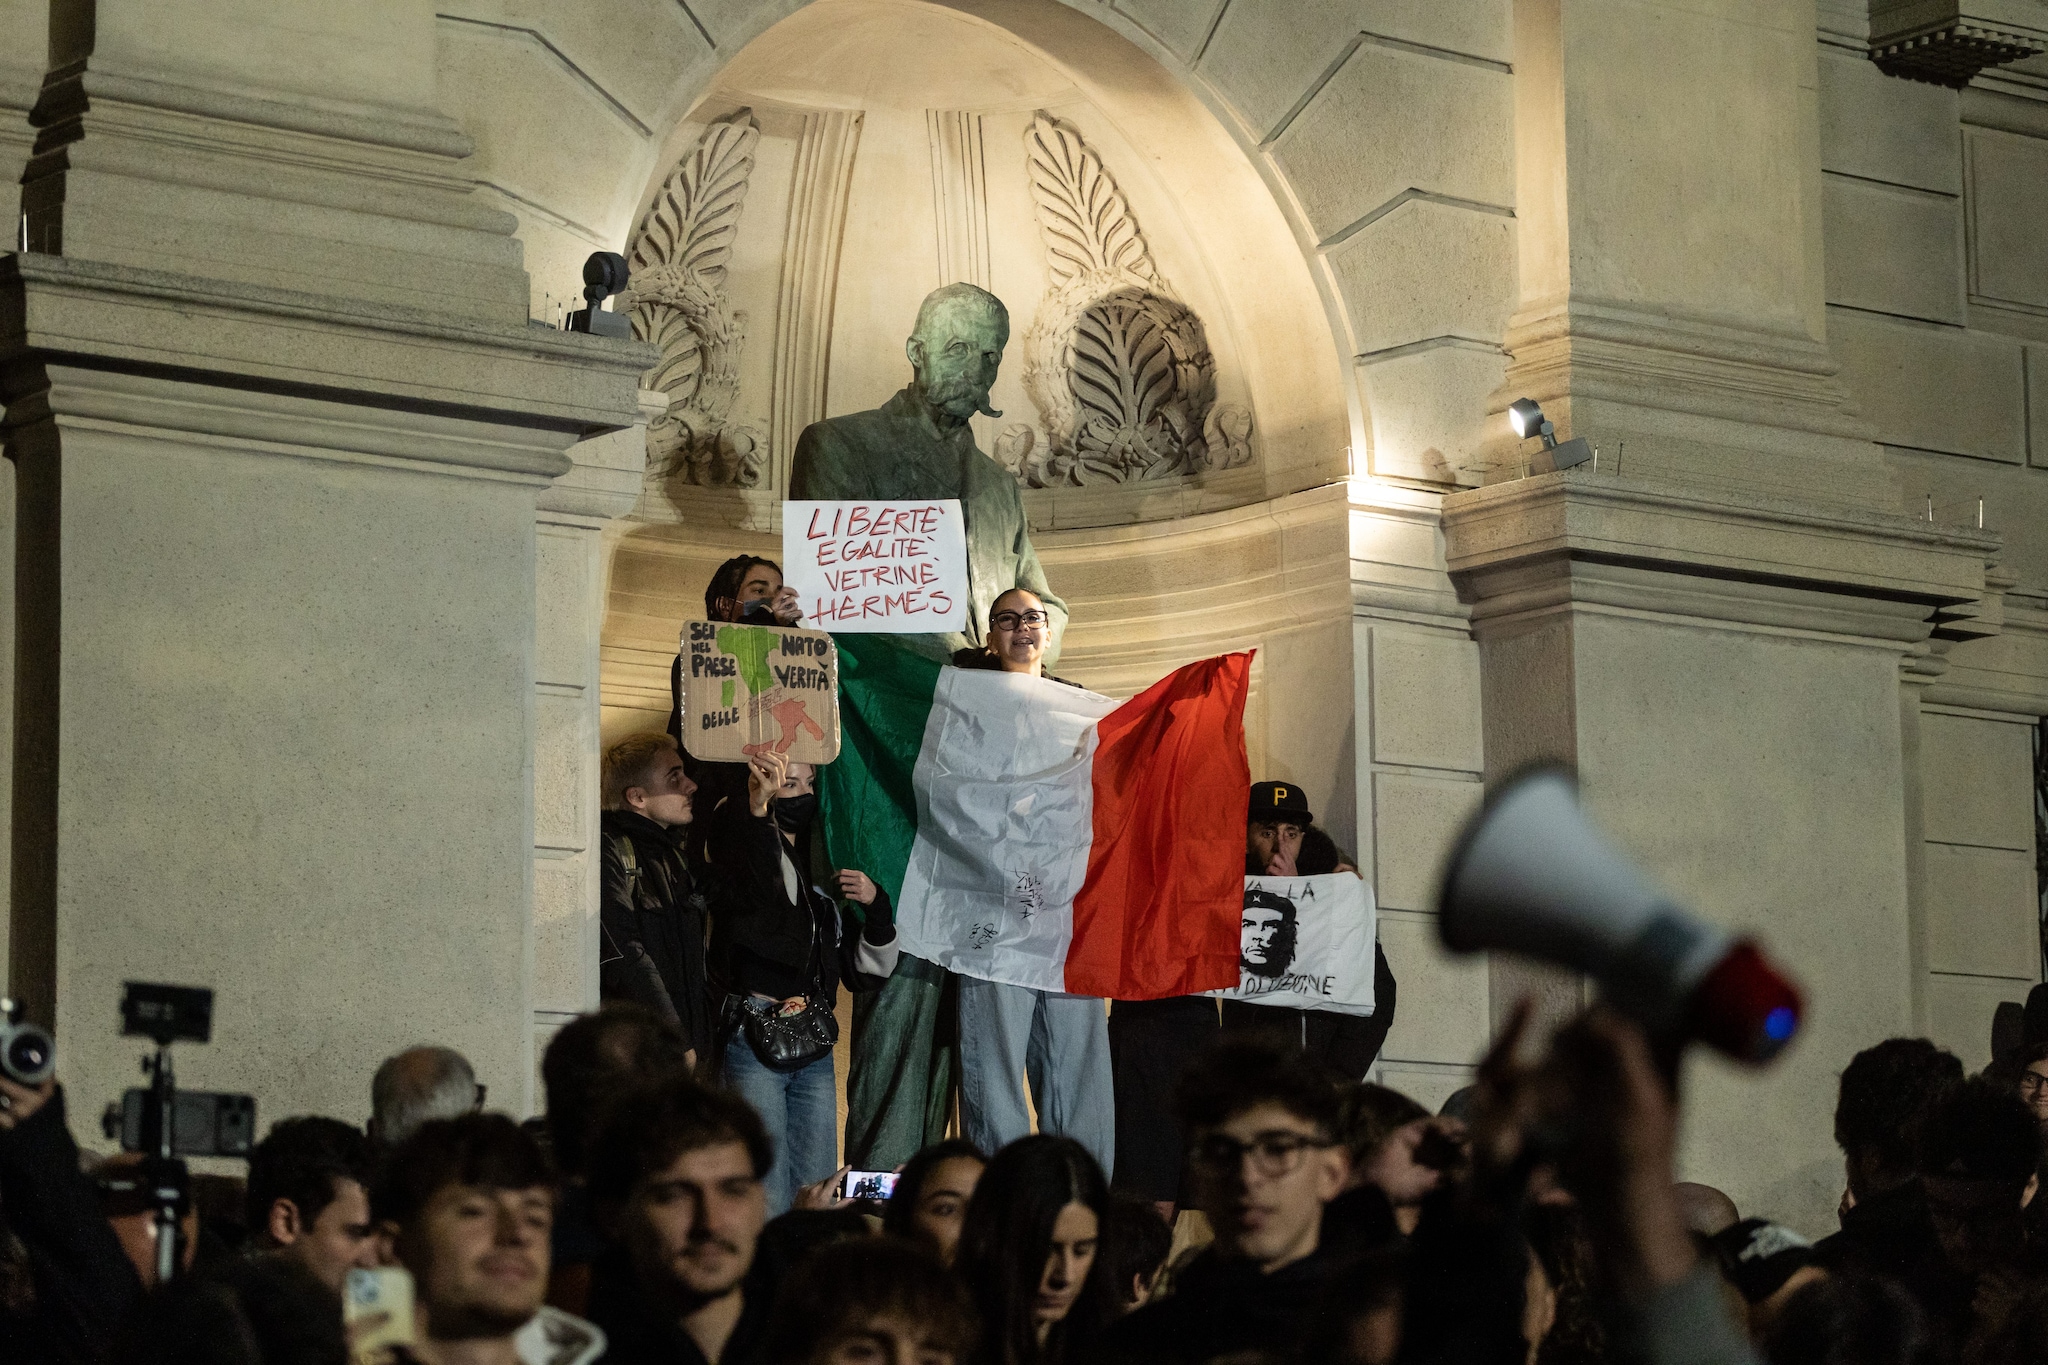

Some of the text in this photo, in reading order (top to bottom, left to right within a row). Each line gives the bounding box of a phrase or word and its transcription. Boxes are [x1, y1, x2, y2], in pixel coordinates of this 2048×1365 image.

[690, 622, 715, 641] SEI
[691, 642, 711, 654] NEL
[781, 633, 828, 657] NATO
[691, 654, 737, 678] PAESE
[774, 660, 830, 692] VERITÀ
[702, 707, 740, 731] DELLE
[1273, 786, 1288, 806] P
[1286, 882, 1316, 902] LA
